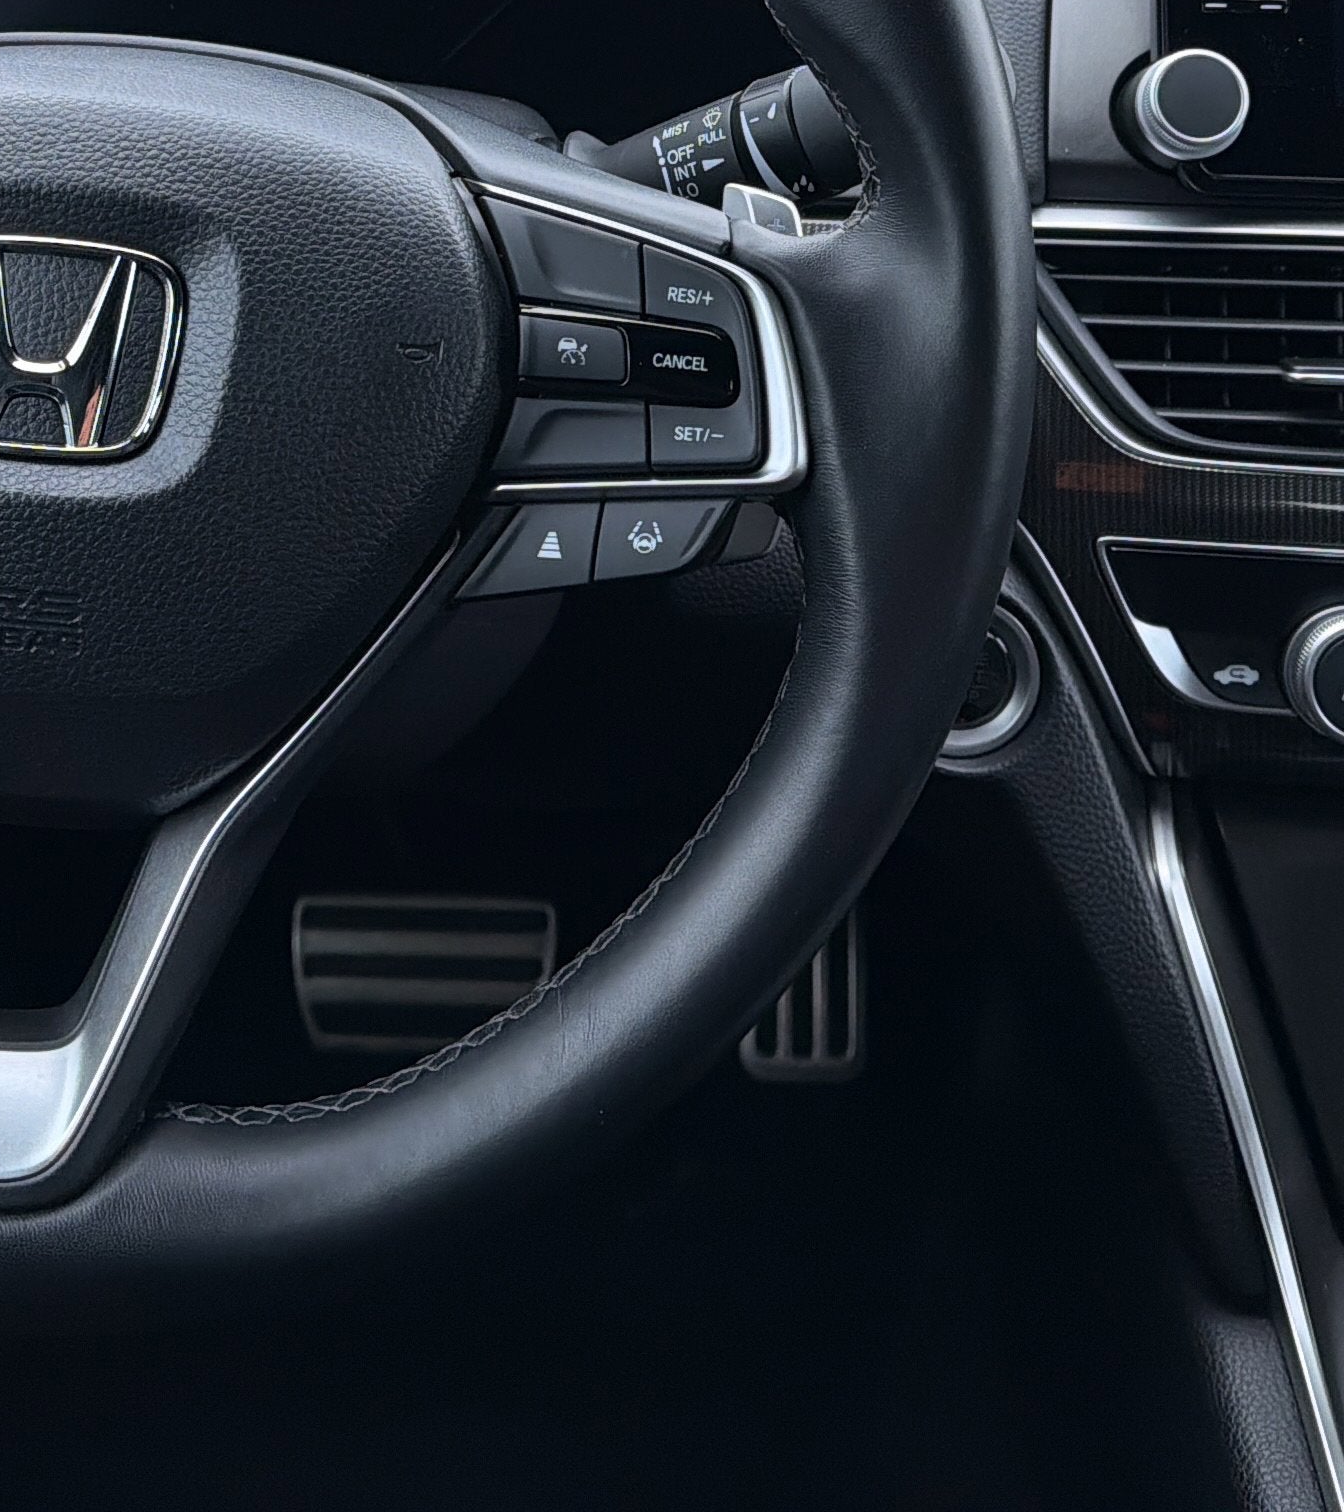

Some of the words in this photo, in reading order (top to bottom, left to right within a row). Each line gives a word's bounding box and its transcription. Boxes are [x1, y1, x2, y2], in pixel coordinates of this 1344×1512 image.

[661, 120, 690, 141] MIST
[697, 127, 727, 147] PULL
[666, 142, 696, 166] OFF
[673, 160, 698, 182] INT
[667, 286, 714, 307] RES/+
[652, 352, 709, 372] CANCEL
